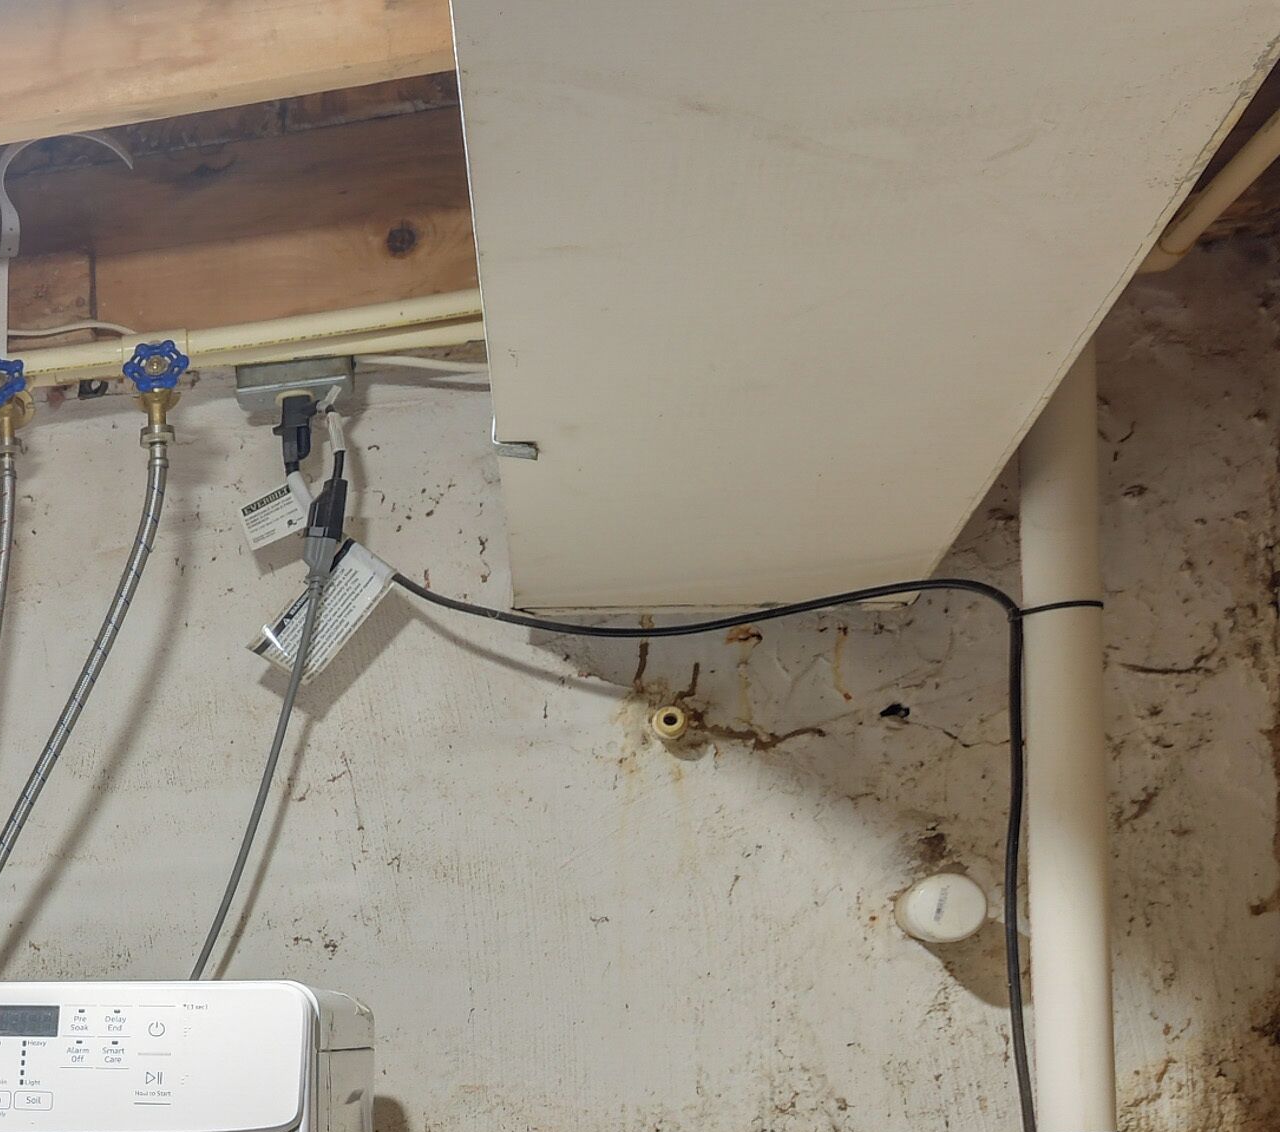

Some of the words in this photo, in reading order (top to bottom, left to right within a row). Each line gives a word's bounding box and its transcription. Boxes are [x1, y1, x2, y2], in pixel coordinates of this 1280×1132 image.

[104, 1015, 127, 1024] Delay
[70, 1023, 89, 1031] Soak
[66, 1046, 90, 1054] Alarm
[102, 1046, 125, 1055] Smart
[71, 1054, 85, 1063] Off
[104, 1055, 122, 1064] Care
[25, 1095, 42, 1104] Soil
